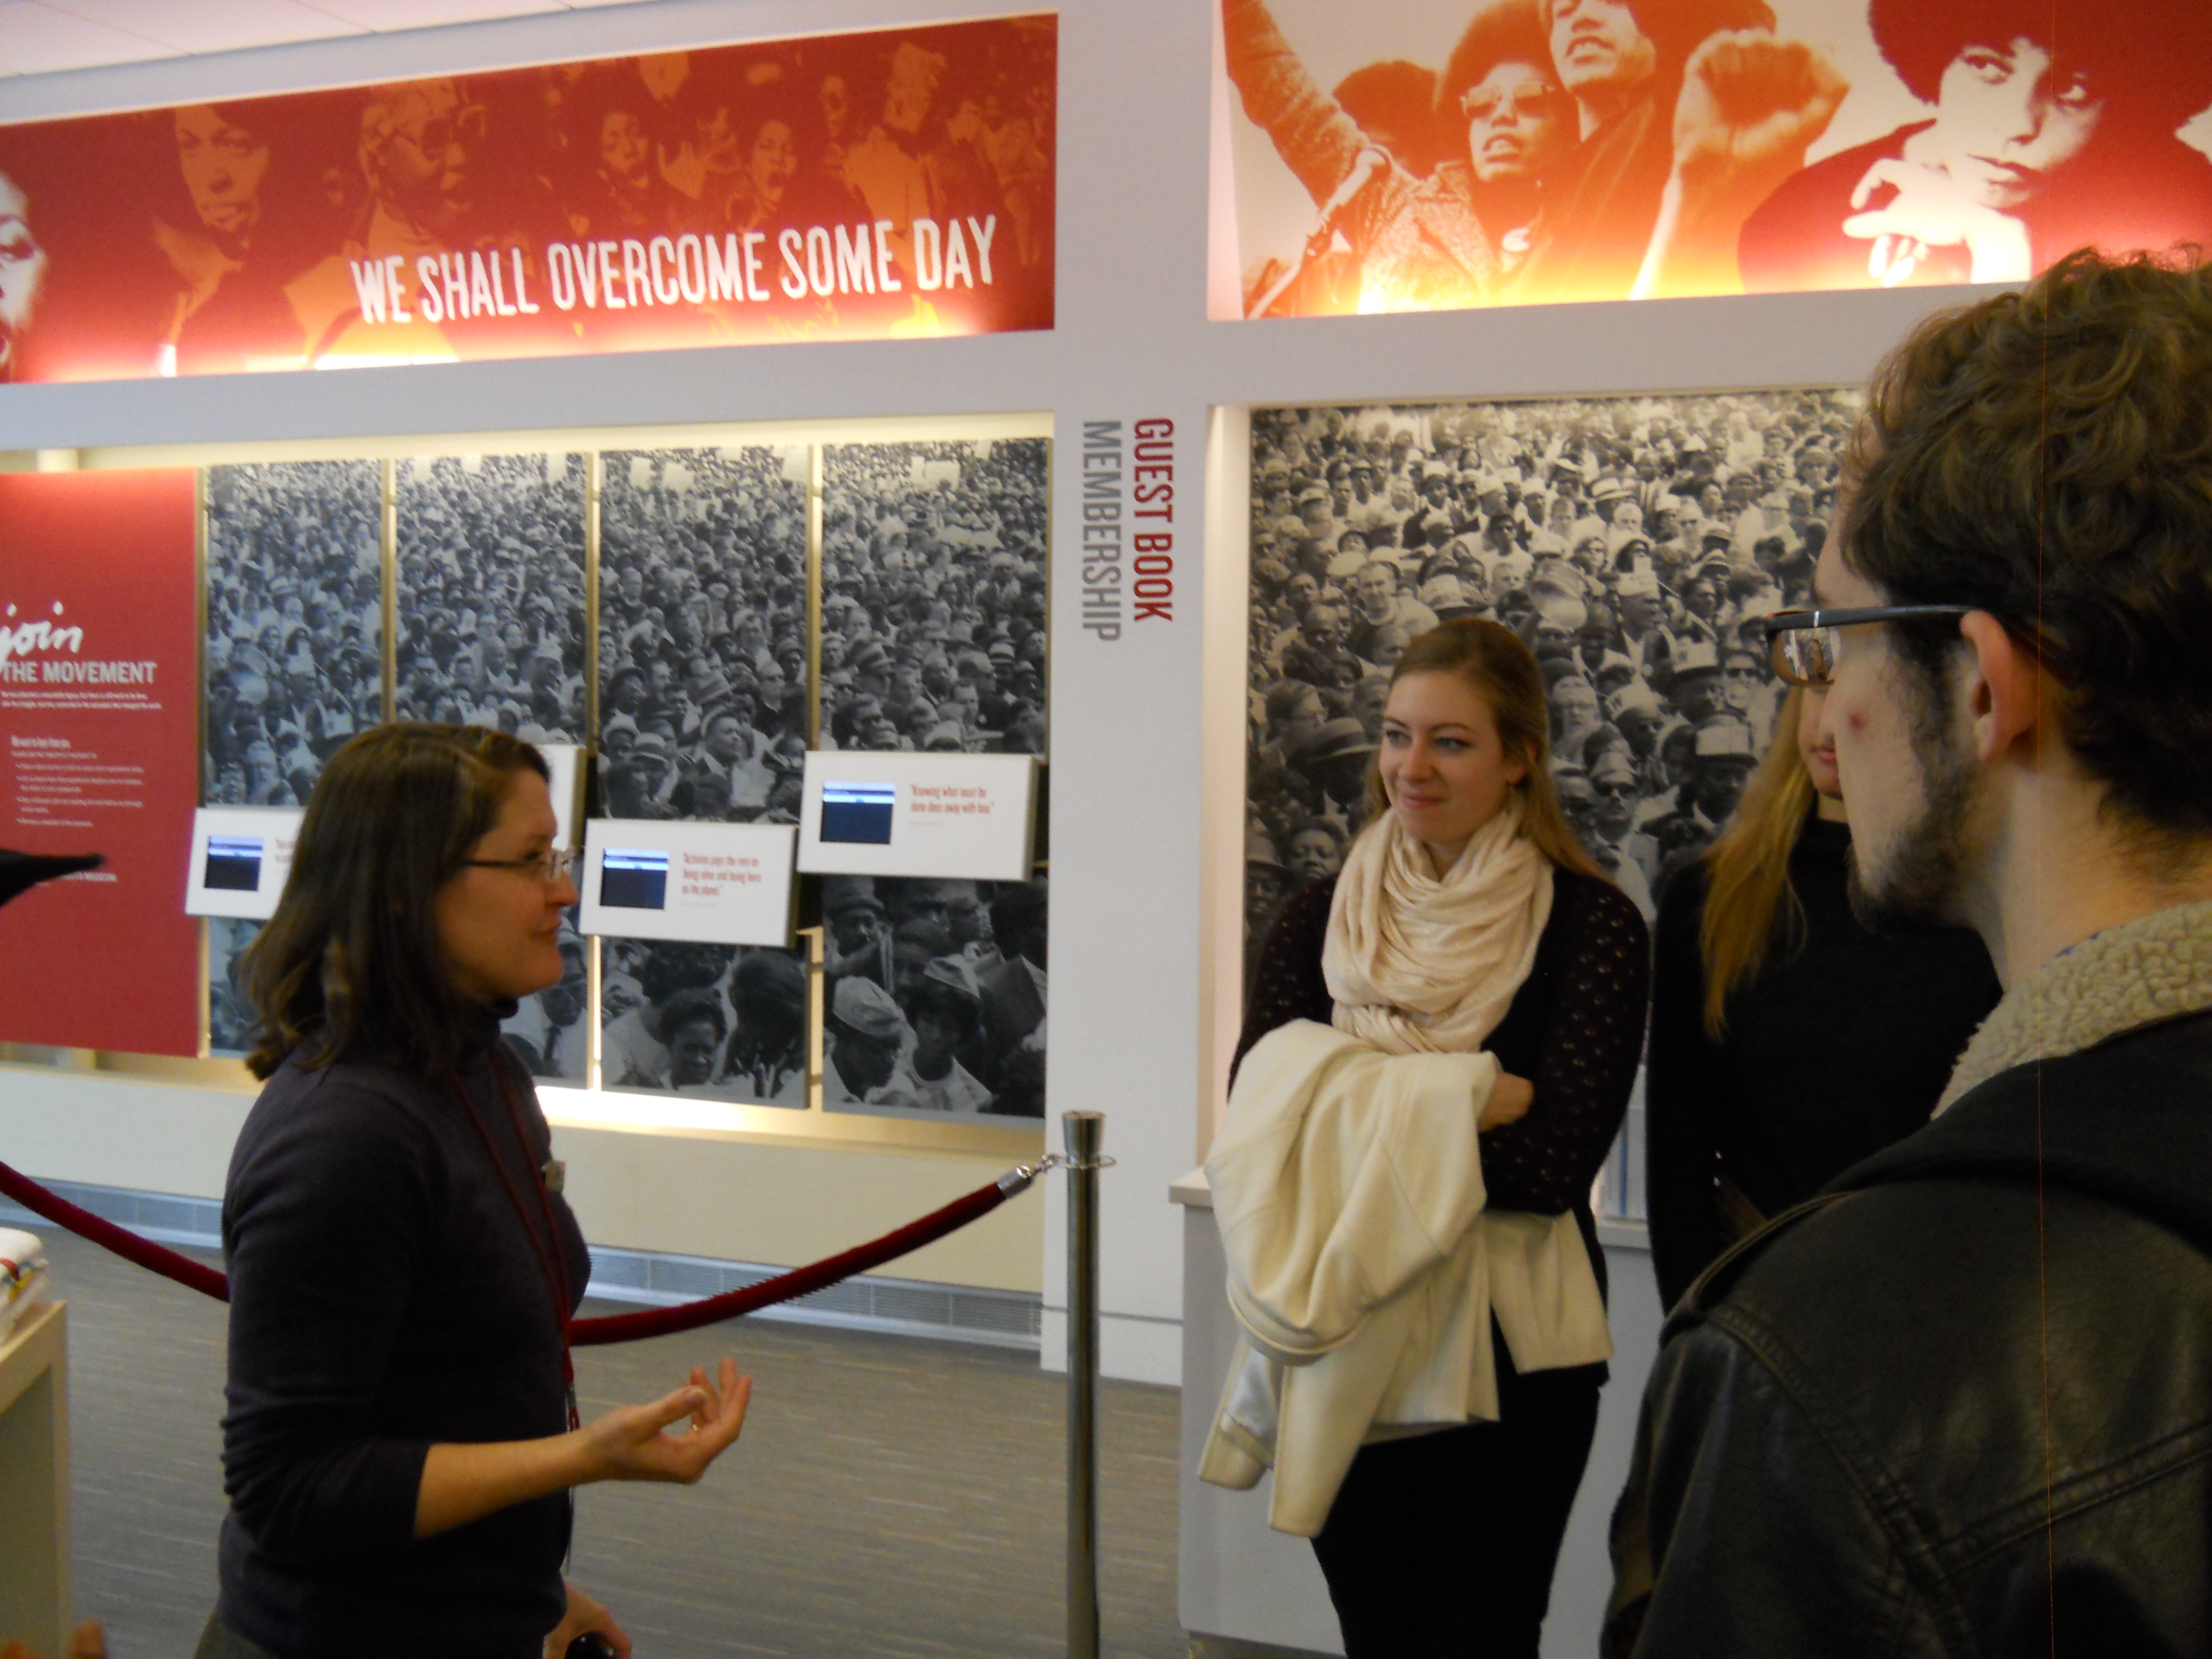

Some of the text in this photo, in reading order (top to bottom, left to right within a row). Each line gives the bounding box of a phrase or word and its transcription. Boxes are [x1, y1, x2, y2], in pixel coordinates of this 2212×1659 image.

[350, 215, 996, 325] WE SHALL OVERCOME SOME DAY
[1081, 419, 1123, 642] MEMBERSHIP
[1133, 417, 1175, 621] GUEST BOOK
[0, 601, 83, 665] join
[2, 660, 157, 684] THE MOVEMENT
